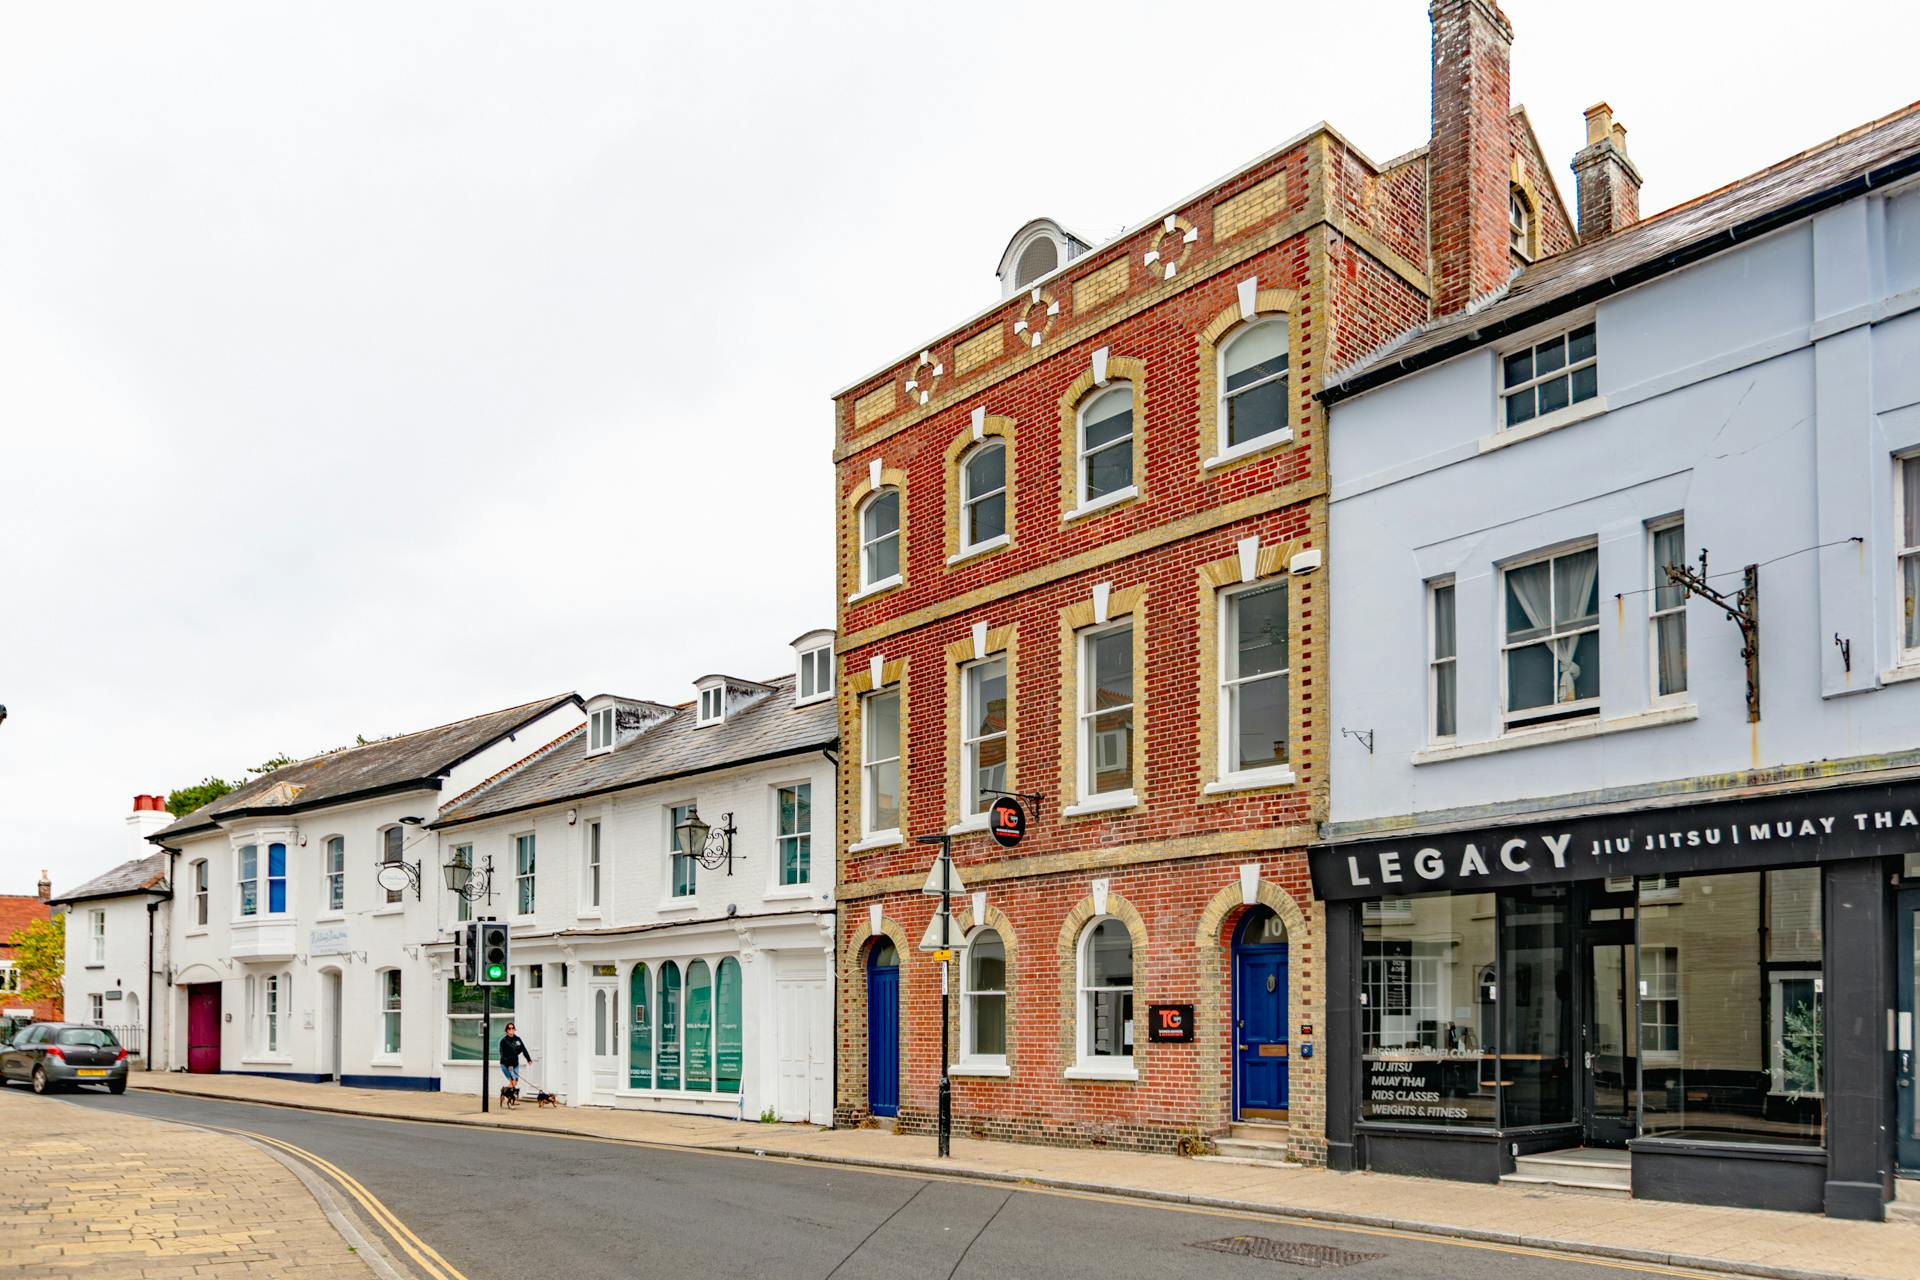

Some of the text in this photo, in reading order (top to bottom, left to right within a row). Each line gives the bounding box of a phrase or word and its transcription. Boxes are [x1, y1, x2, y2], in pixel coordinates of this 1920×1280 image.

[1348, 833, 1571, 886] LEGACY
[1591, 837, 1630, 855] JIU
[1645, 828, 1721, 850] JITSU
[1750, 816, 1835, 841] MUAY
[1853, 809, 1919, 831] THA
[1264, 915, 1283, 937] 10
[1371, 1062, 1413, 1072] JIU JITSU
[1371, 1076, 1425, 1087] MUAY THAI
[1371, 1090, 1440, 1102] KIDS CLASSES
[1371, 1104, 1468, 1118] WEIGHTS & FITNESS
